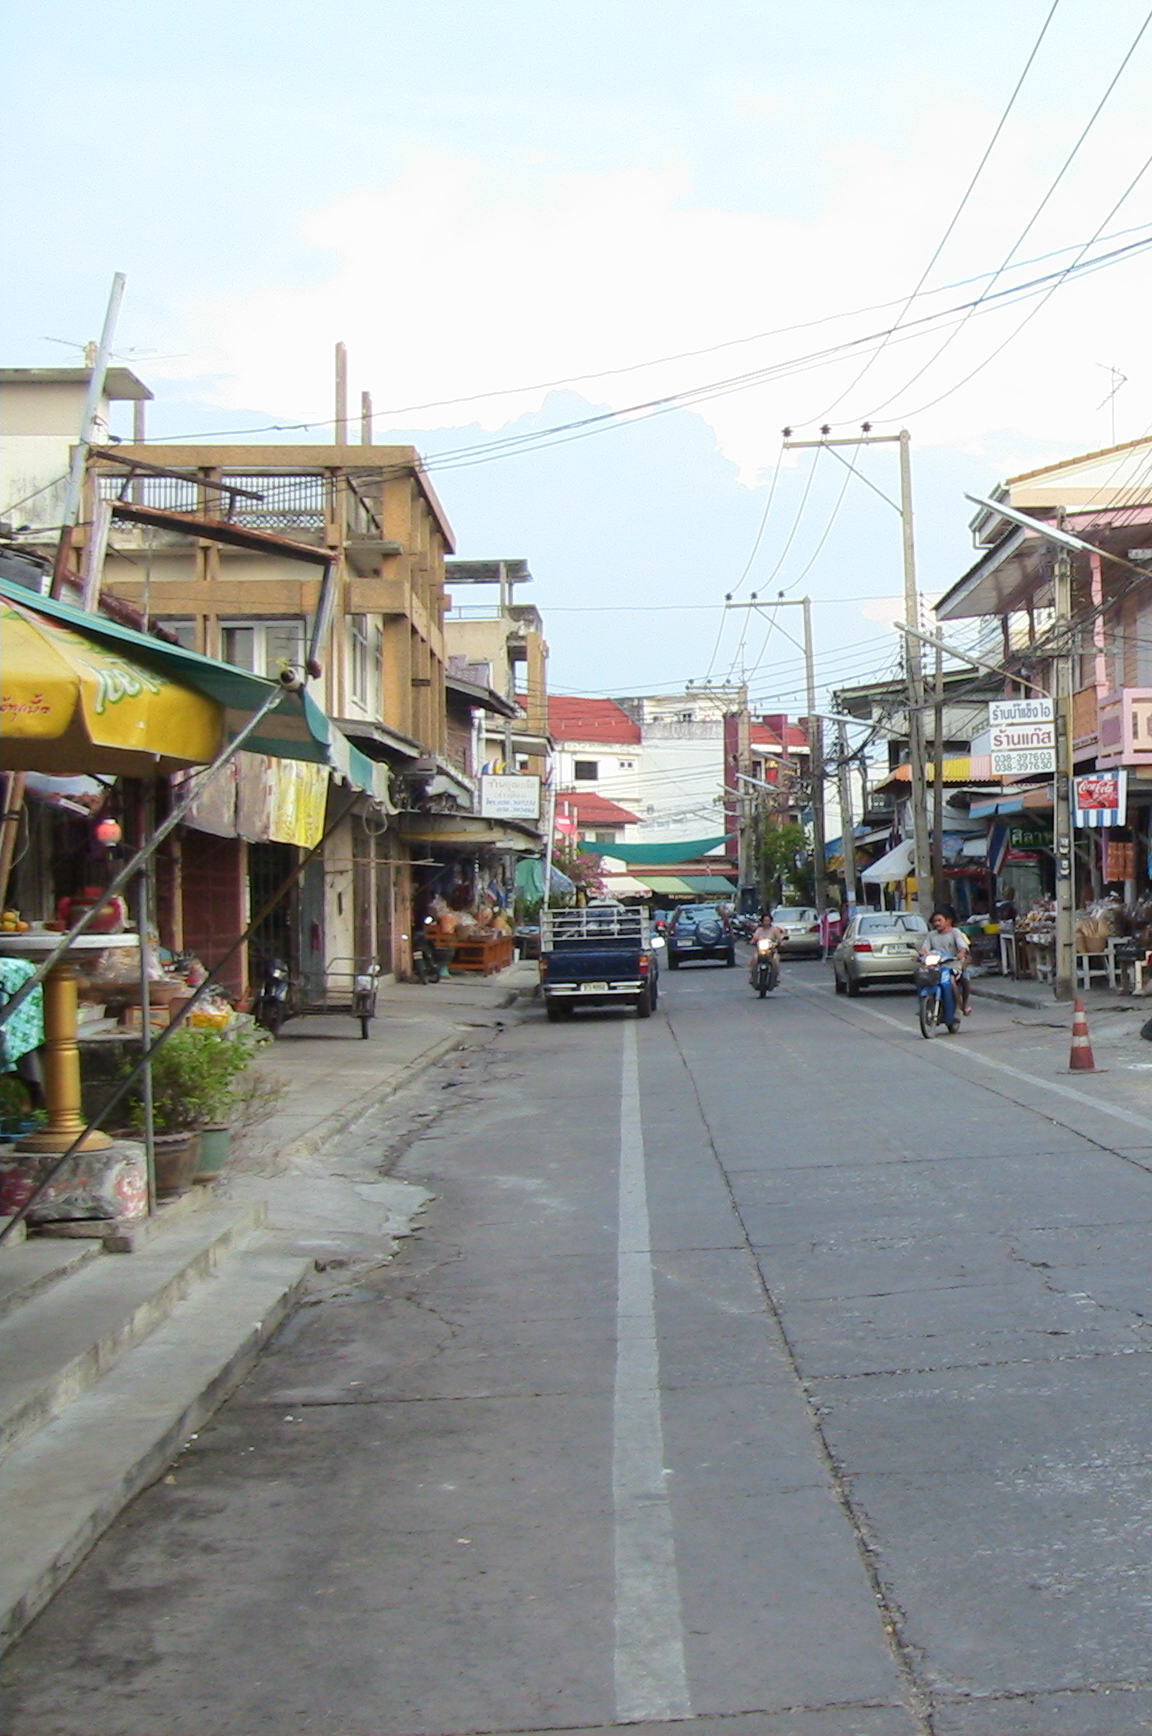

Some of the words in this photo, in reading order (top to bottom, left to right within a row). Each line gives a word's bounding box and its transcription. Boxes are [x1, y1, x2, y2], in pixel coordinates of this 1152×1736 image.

[993, 727, 1052, 747] ร้านแก๊ส
[994, 752, 1052, 763] 038-397603
[995, 761, 1053, 772] 038-397630
